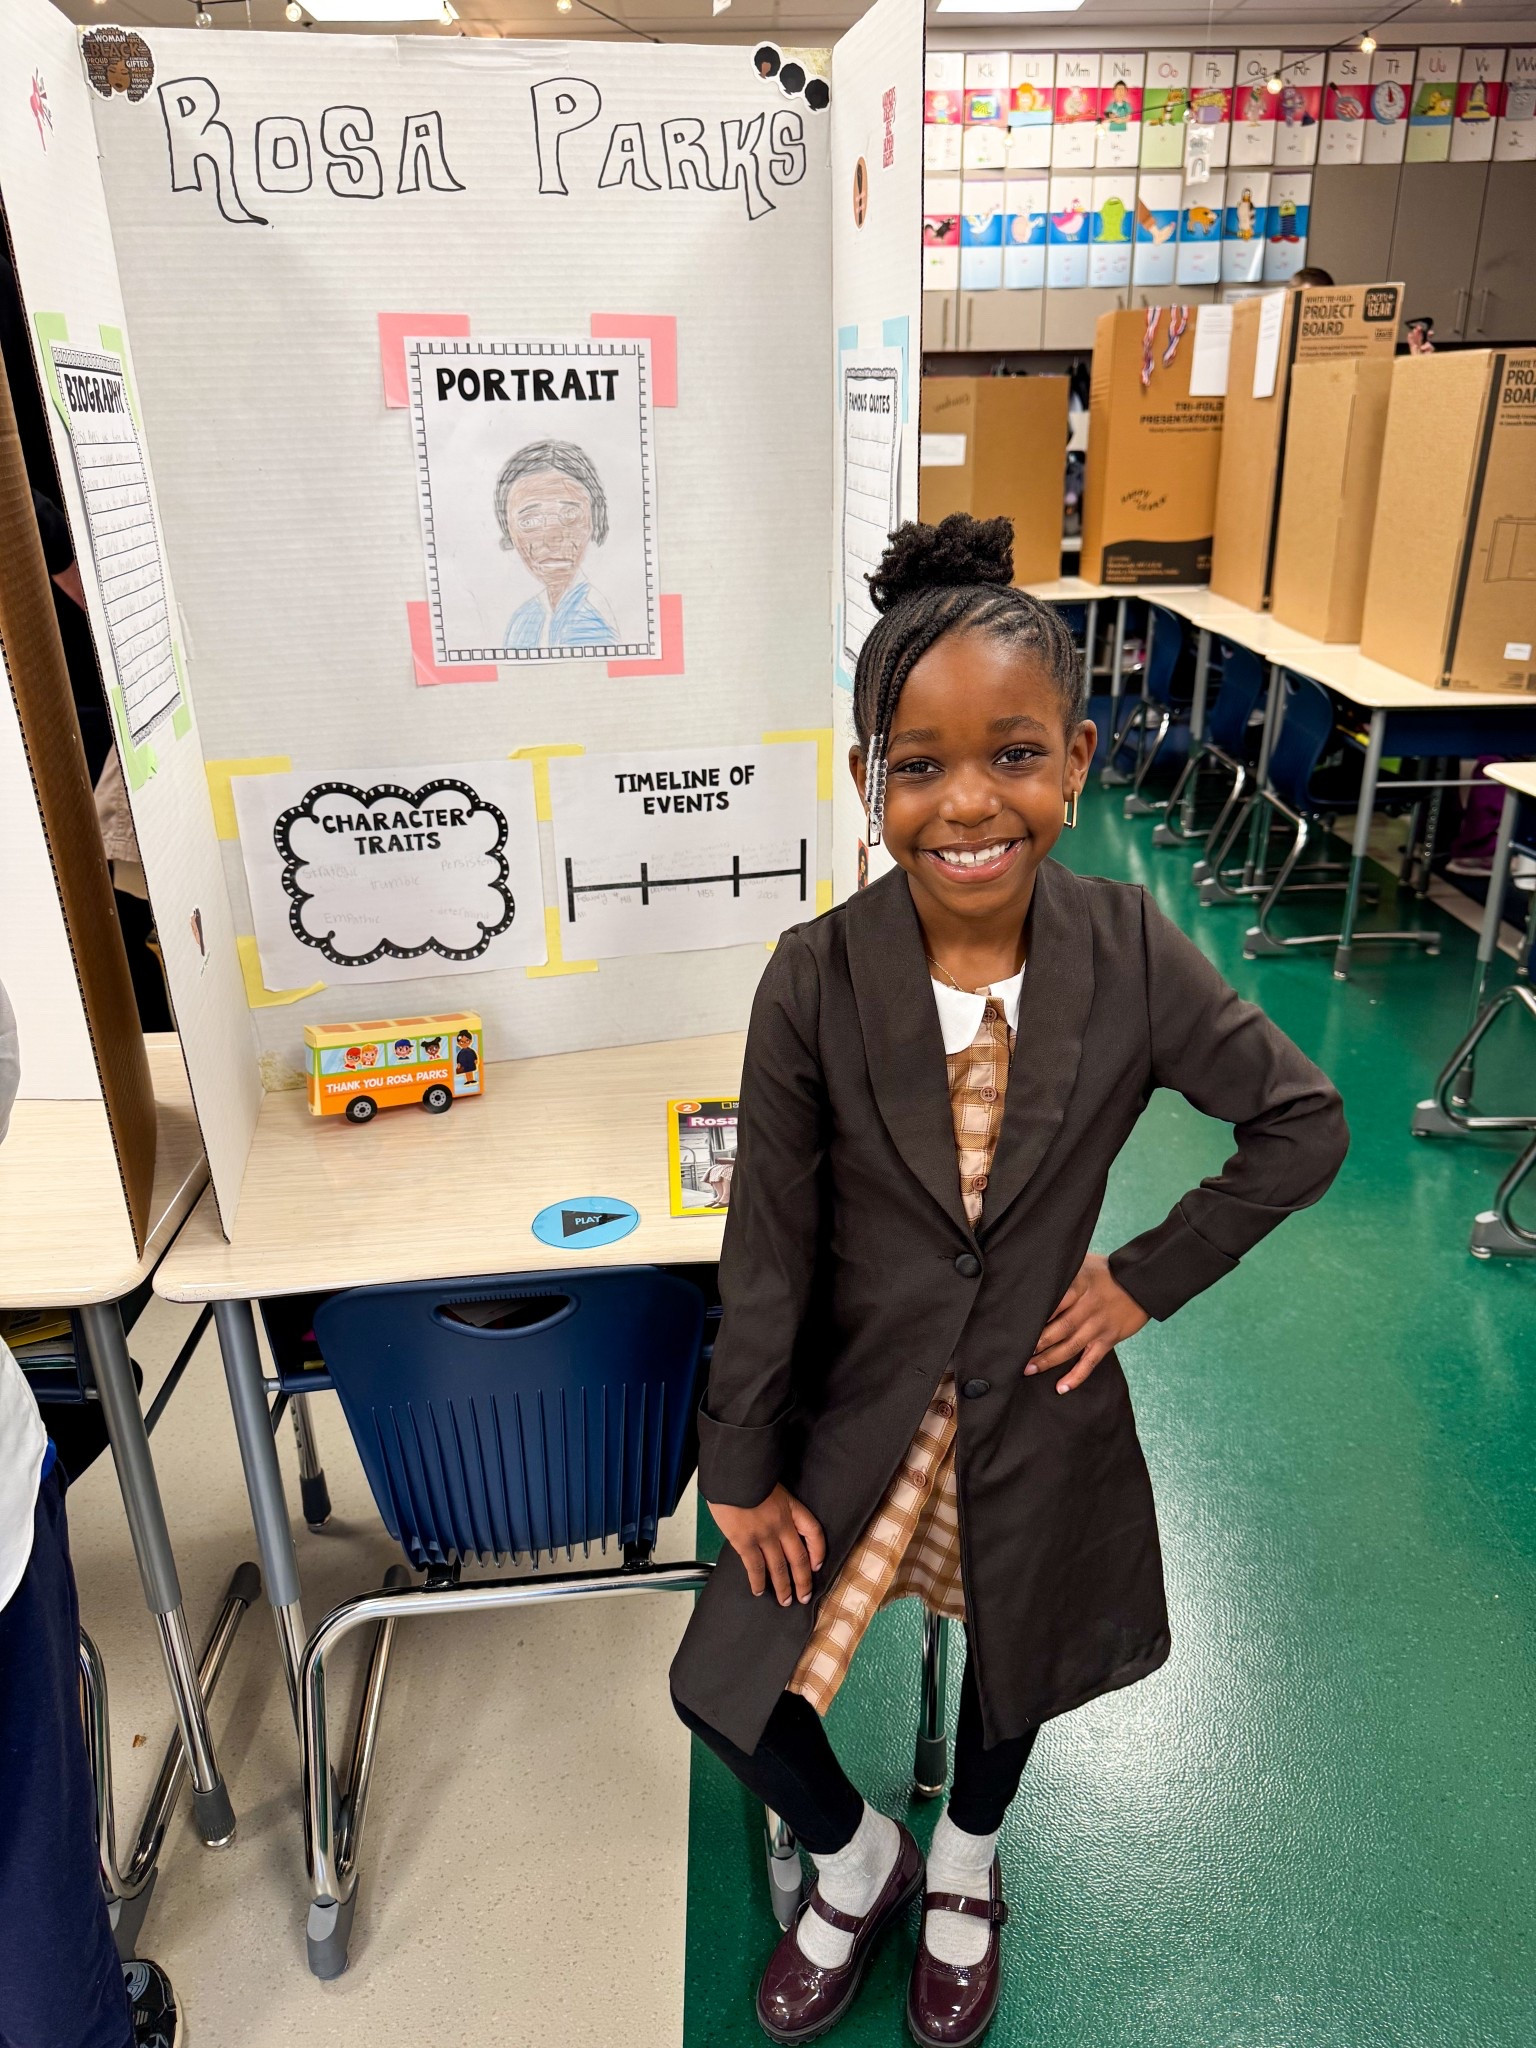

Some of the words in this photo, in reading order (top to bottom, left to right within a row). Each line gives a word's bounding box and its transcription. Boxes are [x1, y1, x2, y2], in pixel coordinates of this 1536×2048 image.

[94, 34, 126, 43] WOMAN
[89, 42, 141, 58] BLACK
[125, 60, 149, 68] GIFTED
[1158, 62, 1179, 78] Oo
[1340, 59, 1357, 75] Ss
[1428, 57, 1446, 73] Uu
[157, 76, 467, 226] ROSA
[531, 76, 806, 221] PARKS
[1303, 304, 1355, 320] PROJECT
[1301, 321, 1345, 337] BOARD
[436, 367, 619, 402] PORTRAIT
[1506, 369, 1536, 386] PRO
[64, 373, 125, 414] BIOGRAPHY
[849, 392, 867, 413] FAMOUS
[869, 394, 890, 414] QUOTES
[1139, 414, 1218, 425] PRESENTATION
[615, 768, 720, 793] TIMELINE
[729, 764, 755, 785] OF
[643, 791, 730, 815] EVENTS
[322, 808, 468, 834] CHARACTER
[354, 832, 441, 855] TRAITS
[325, 1081, 361, 1094] THANK
[362, 1077, 384, 1089] YOU
[386, 1072, 413, 1086] ROSA
[416, 1069, 448, 1082] PARKS
[683, 1104, 692, 1112] 2
[690, 1116, 738, 1127] Rosa
[574, 1215, 602, 1226] PLAY
